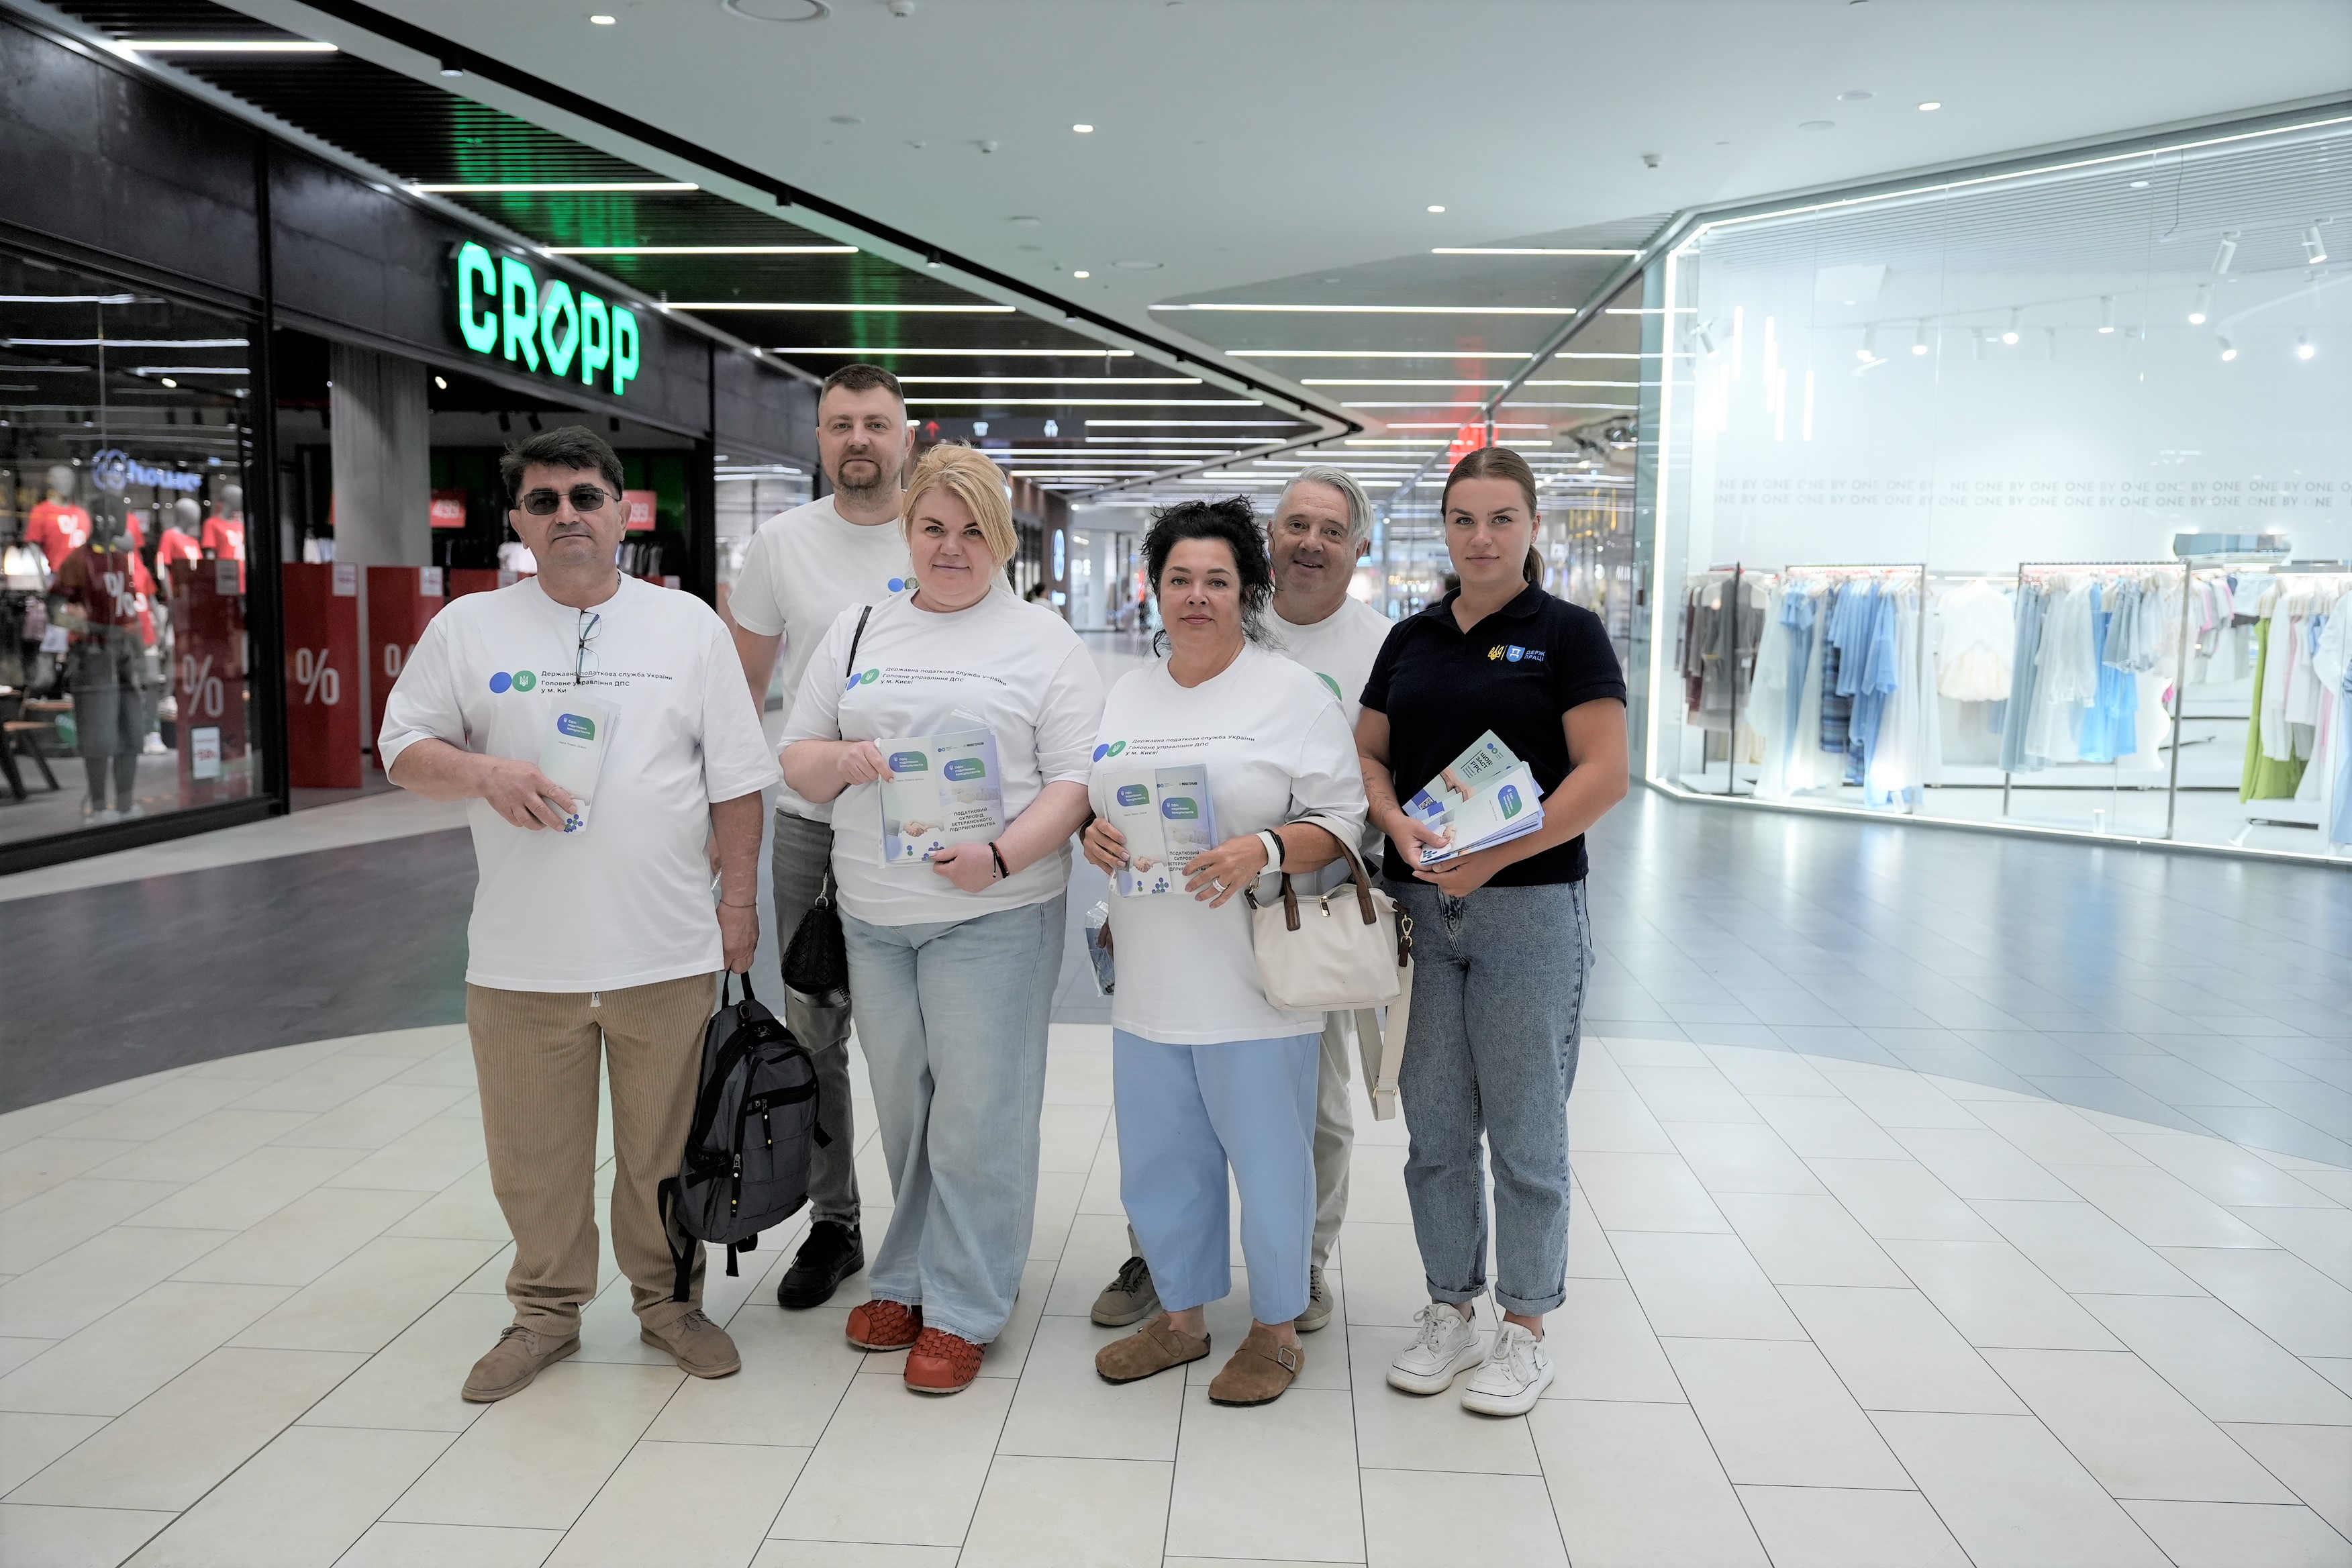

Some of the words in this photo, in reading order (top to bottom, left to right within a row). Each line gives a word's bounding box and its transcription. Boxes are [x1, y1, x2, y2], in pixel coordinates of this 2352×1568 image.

[458, 240, 640, 396] CROPP
[1715, 479, 1737, 490] NE
[1742, 479, 1757, 490] BY
[1762, 479, 1790, 490] ONE
[1830, 479, 1847, 491] BY
[1851, 479, 1879, 491] ONE
[1886, 479, 1915, 491] ONE
[1919, 479, 1933, 491] BY
[1945, 480, 1968, 491] NE
[1975, 480, 2003, 491] ONE
[2009, 480, 2025, 491] BY
[2030, 481, 2059, 492] ONE
[2065, 481, 2095, 492] ONE
[2100, 481, 2116, 492] BY
[2121, 481, 2150, 492] ONE
[2192, 481, 2208, 492] BY
[2212, 481, 2243, 492] ONE
[2249, 481, 2279, 492] ONE
[2284, 481, 2300, 492] BY
[2304, 481, 2334, 492] ONE
[1741, 493, 1757, 505] BY
[1761, 493, 1790, 505] ONE
[1796, 493, 1825, 505] ONE
[1830, 494, 1846, 505] BY
[1851, 494, 1879, 505] ONE
[1884, 494, 1914, 505] ONE
[1918, 494, 1932, 505] BY
[1939, 495, 1967, 506] ONE
[1974, 495, 2002, 506] ONE
[2008, 495, 2024, 506] BY
[2029, 495, 2058, 507] ONE
[2064, 495, 2094, 507] ONE
[2099, 495, 2115, 507] BY
[2120, 495, 2149, 507] ONE
[2155, 495, 2185, 507] ONE
[2190, 495, 2207, 507] BY
[2211, 495, 2241, 507] ONE
[2247, 495, 2277, 507] ONE
[2282, 495, 2299, 507] BY
[1480, 752, 1493, 765] ЩОД
[953, 807, 987, 816] ПОДАТКОВИЙ
[959, 813, 984, 821] СУПРОВІД
[949, 822, 996, 832] ПІДПРИЄМНИЦТВА
[951, 817, 993, 827] ВЕТЕРАНСЬКОГО
